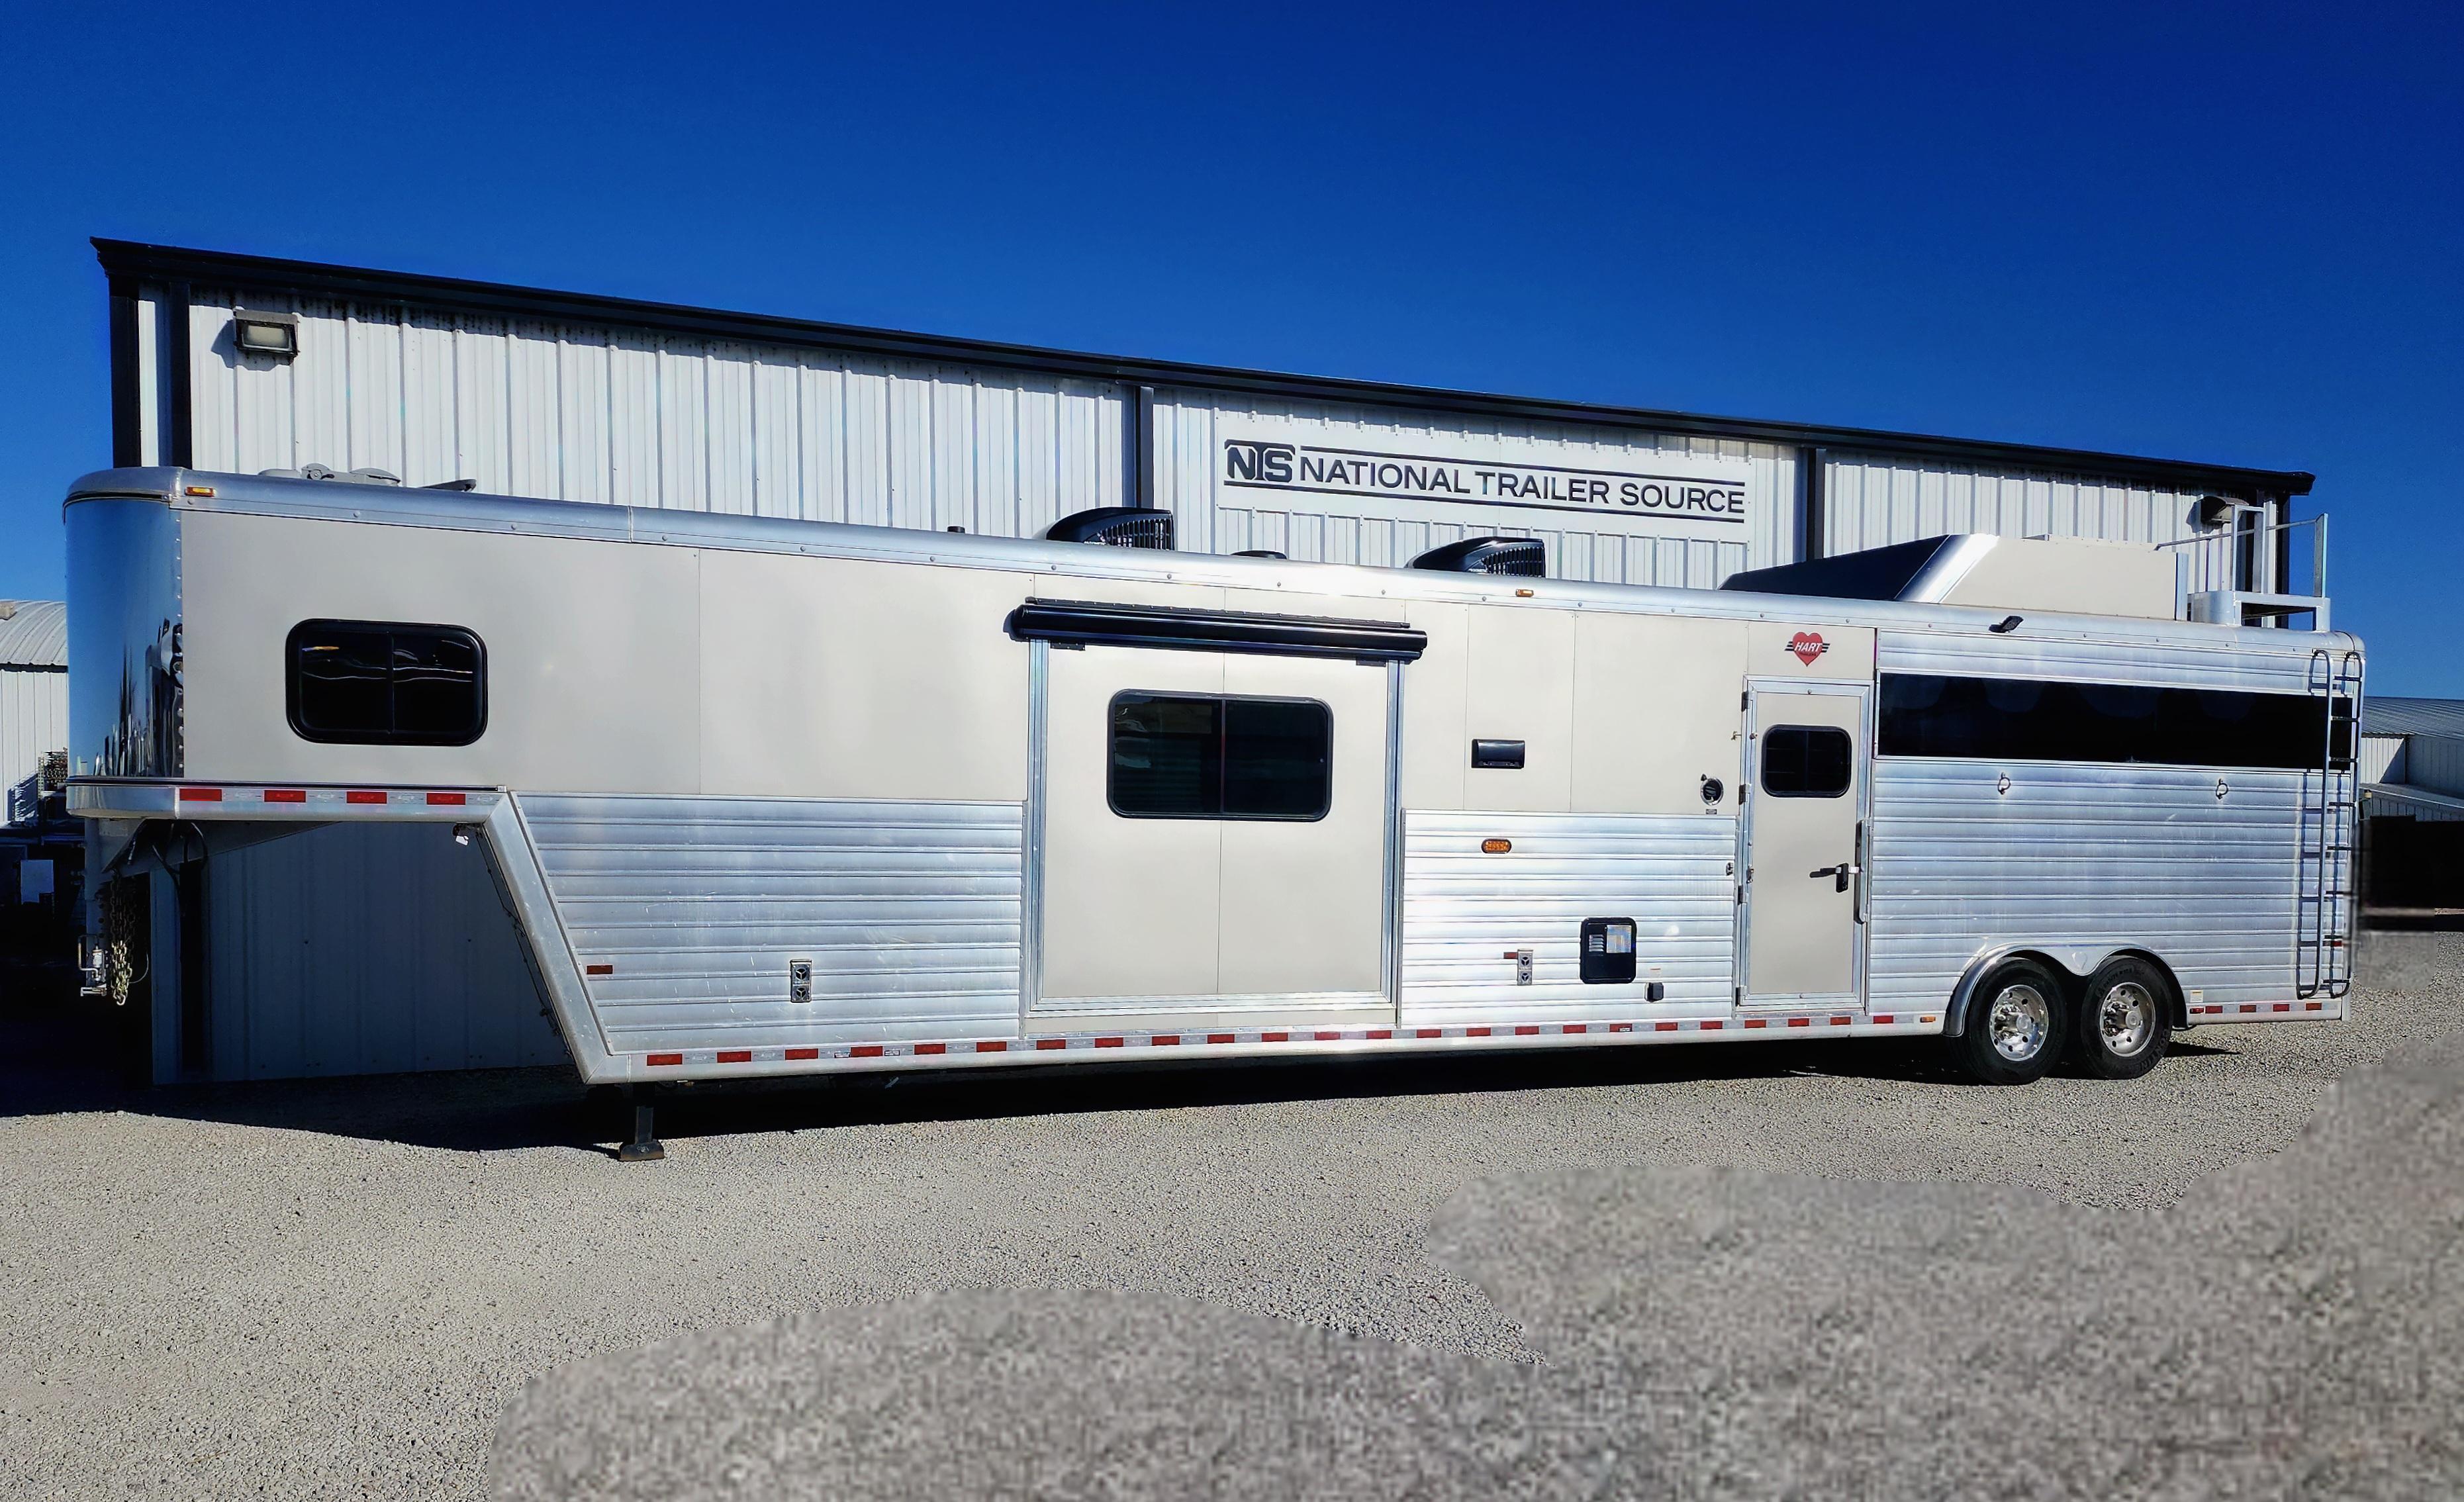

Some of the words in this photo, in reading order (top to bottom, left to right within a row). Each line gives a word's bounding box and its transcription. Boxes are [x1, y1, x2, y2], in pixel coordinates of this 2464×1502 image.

[1224, 439, 1296, 483] NTS
[1300, 456, 1471, 494] NATIONAL
[1474, 471, 1610, 504] TRAILER
[1620, 482, 1745, 514] SOURCE
[1794, 641, 1823, 652] HART
